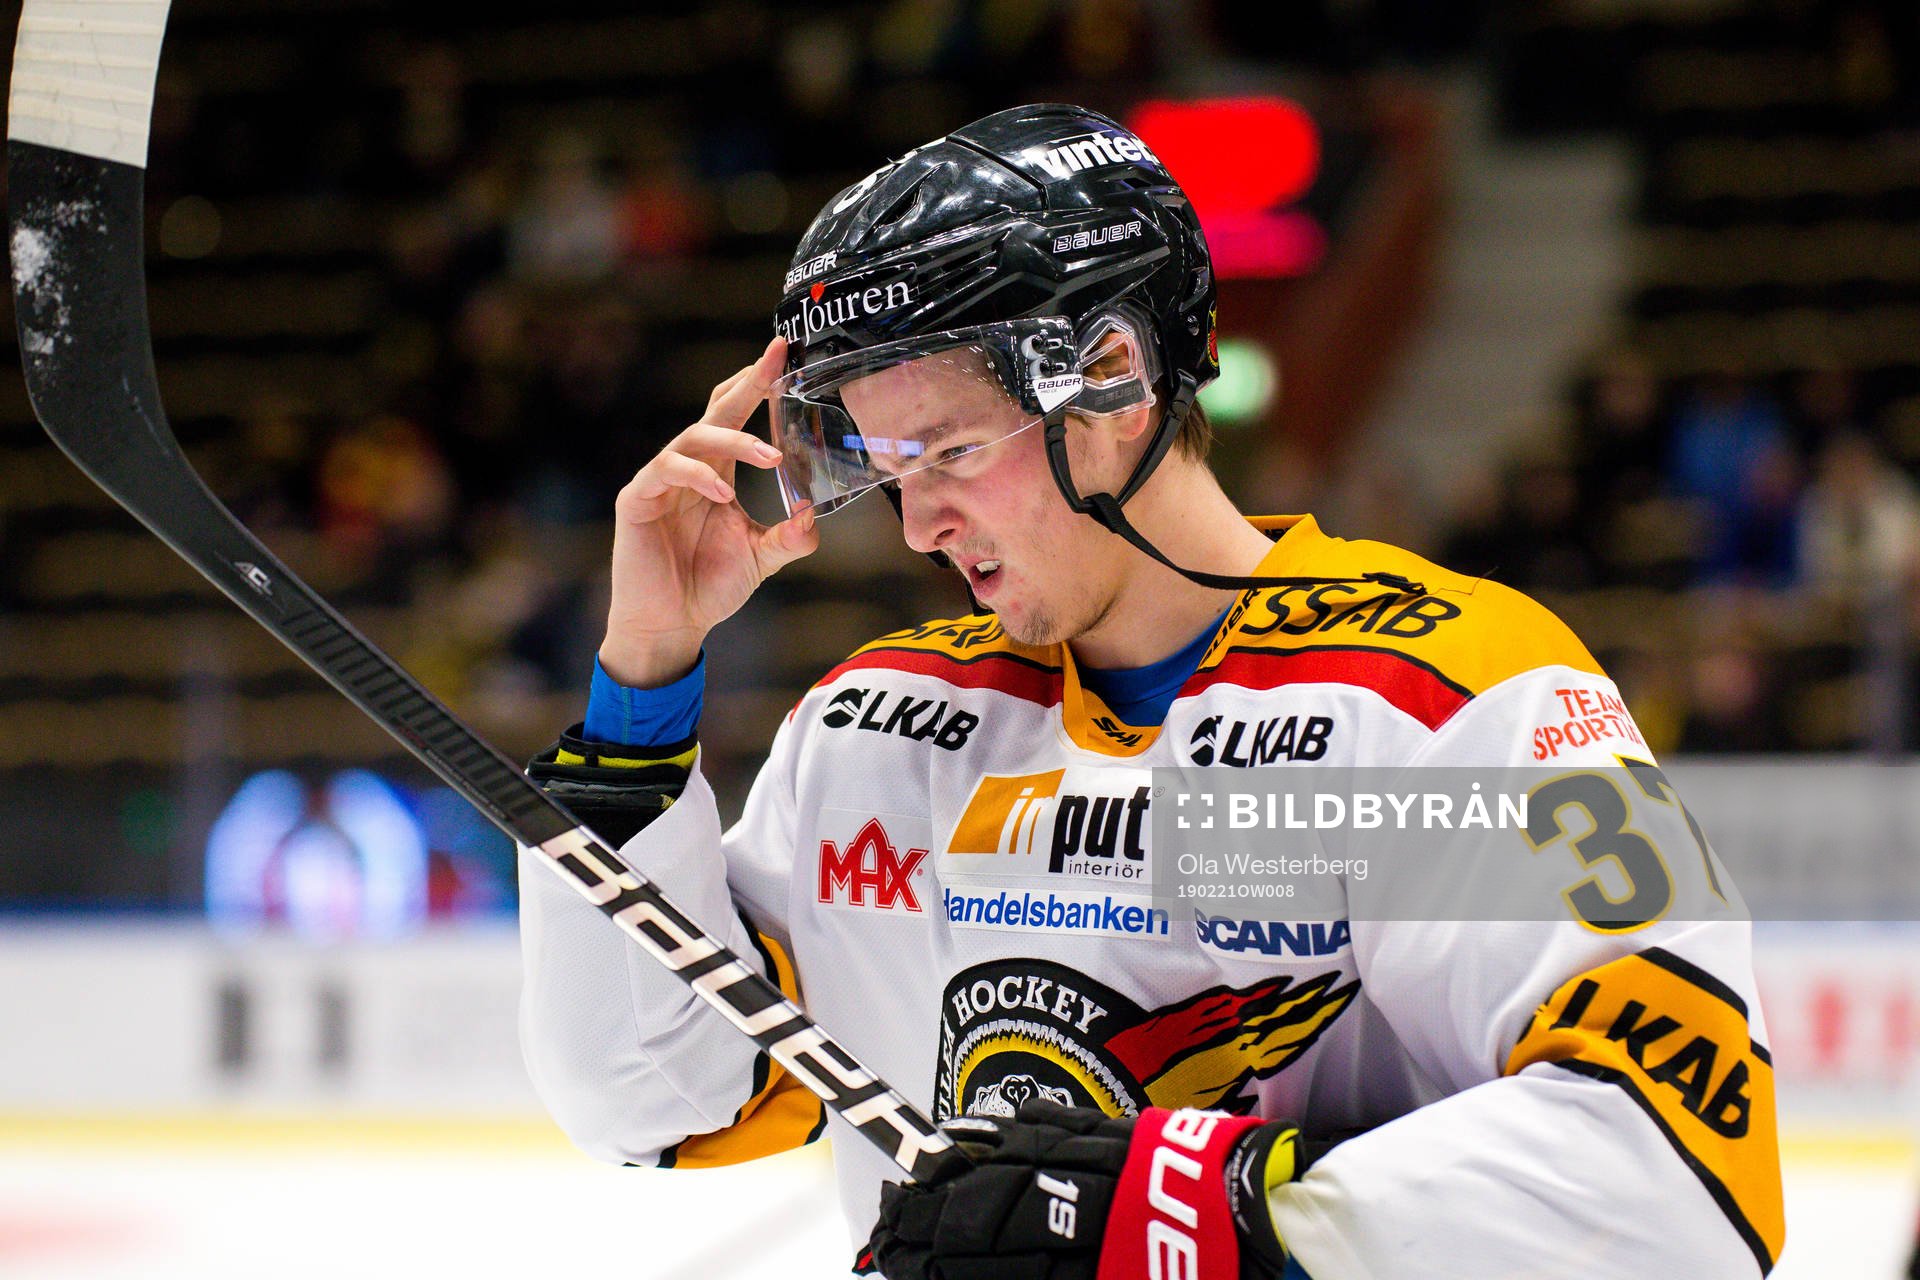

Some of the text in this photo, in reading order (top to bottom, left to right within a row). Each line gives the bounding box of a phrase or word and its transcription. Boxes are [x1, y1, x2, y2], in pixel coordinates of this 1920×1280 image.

[1239, 584, 1462, 638] SSAB
[857, 690, 980, 751] LKAB
[1219, 715, 1335, 768] LKAB
[996, 786, 1152, 873] input
[818, 817, 930, 913] MAX
[1068, 859, 1145, 879] interiör
[1194, 907, 1351, 957] SCANIA
[951, 975, 1108, 1035] HOCKEY
